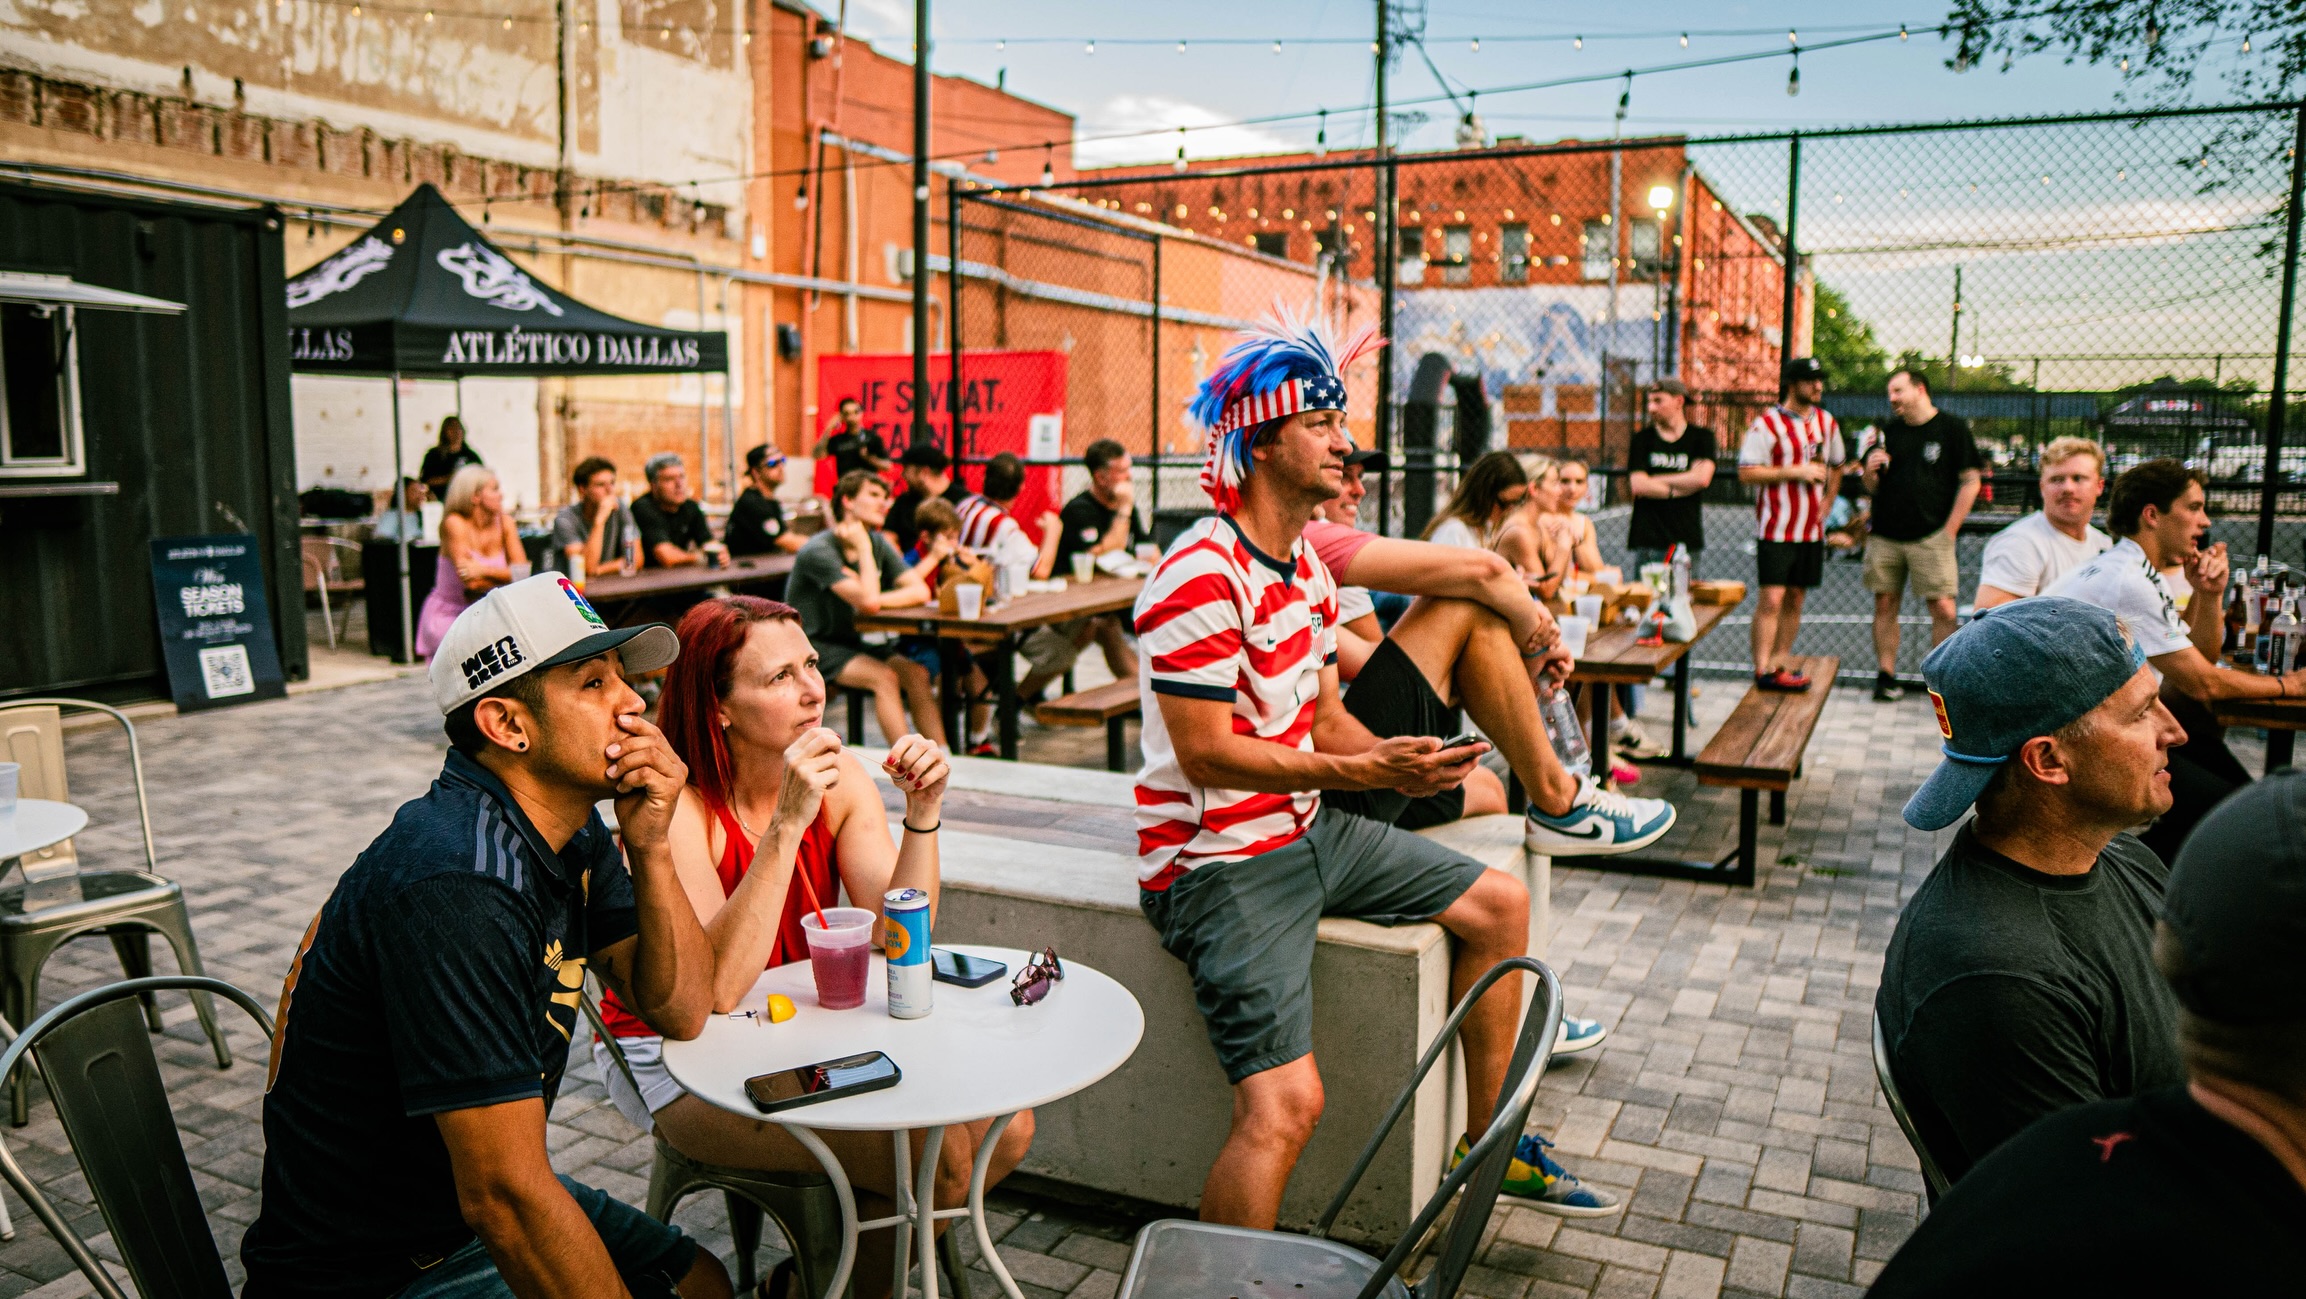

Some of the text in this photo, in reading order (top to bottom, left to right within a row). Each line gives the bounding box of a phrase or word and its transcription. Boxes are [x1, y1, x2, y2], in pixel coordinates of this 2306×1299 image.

[443, 324, 700, 367] ATLÉTICO DALLAS
[862, 381, 886, 412] IF
[181, 583, 244, 605] SEASON
[184, 600, 246, 618] TICKETS
[461, 644, 498, 677] WE
[468, 660, 504, 690] ARE
